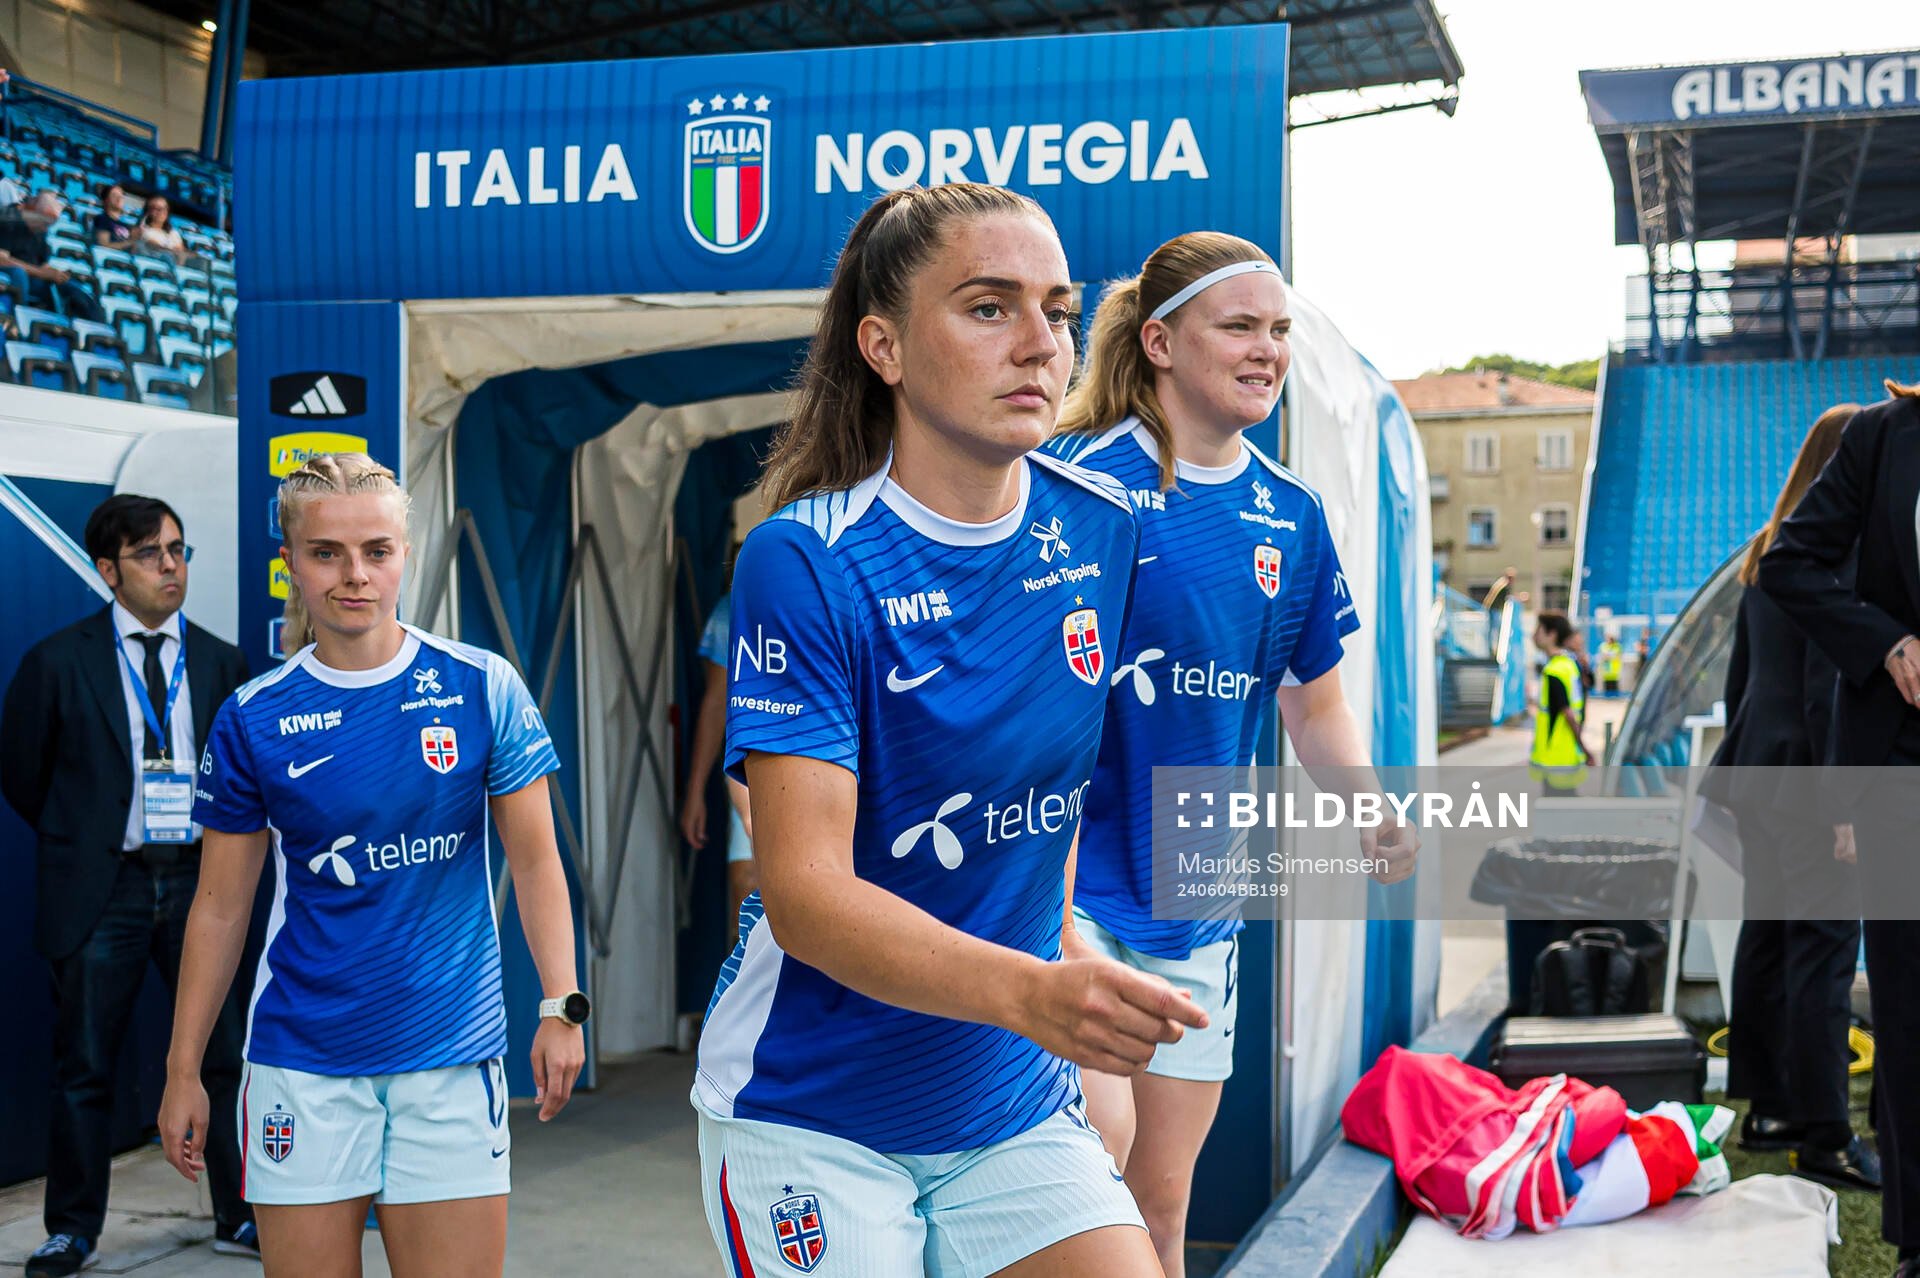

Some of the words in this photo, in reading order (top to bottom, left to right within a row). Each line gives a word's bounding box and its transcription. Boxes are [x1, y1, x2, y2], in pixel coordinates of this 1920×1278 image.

[692, 127, 762, 155] ITALIA
[415, 143, 639, 208] ITALIA
[815, 118, 1209, 194] NORVEGIA
[1022, 571, 1061, 593] Norsk
[1059, 563, 1101, 583] Tipping
[732, 624, 787, 682] NB
[401, 698, 430, 712] Norsk
[429, 694, 464, 708] Tipping
[731, 696, 803, 715] nvesterer
[279, 713, 323, 735] KIWI
